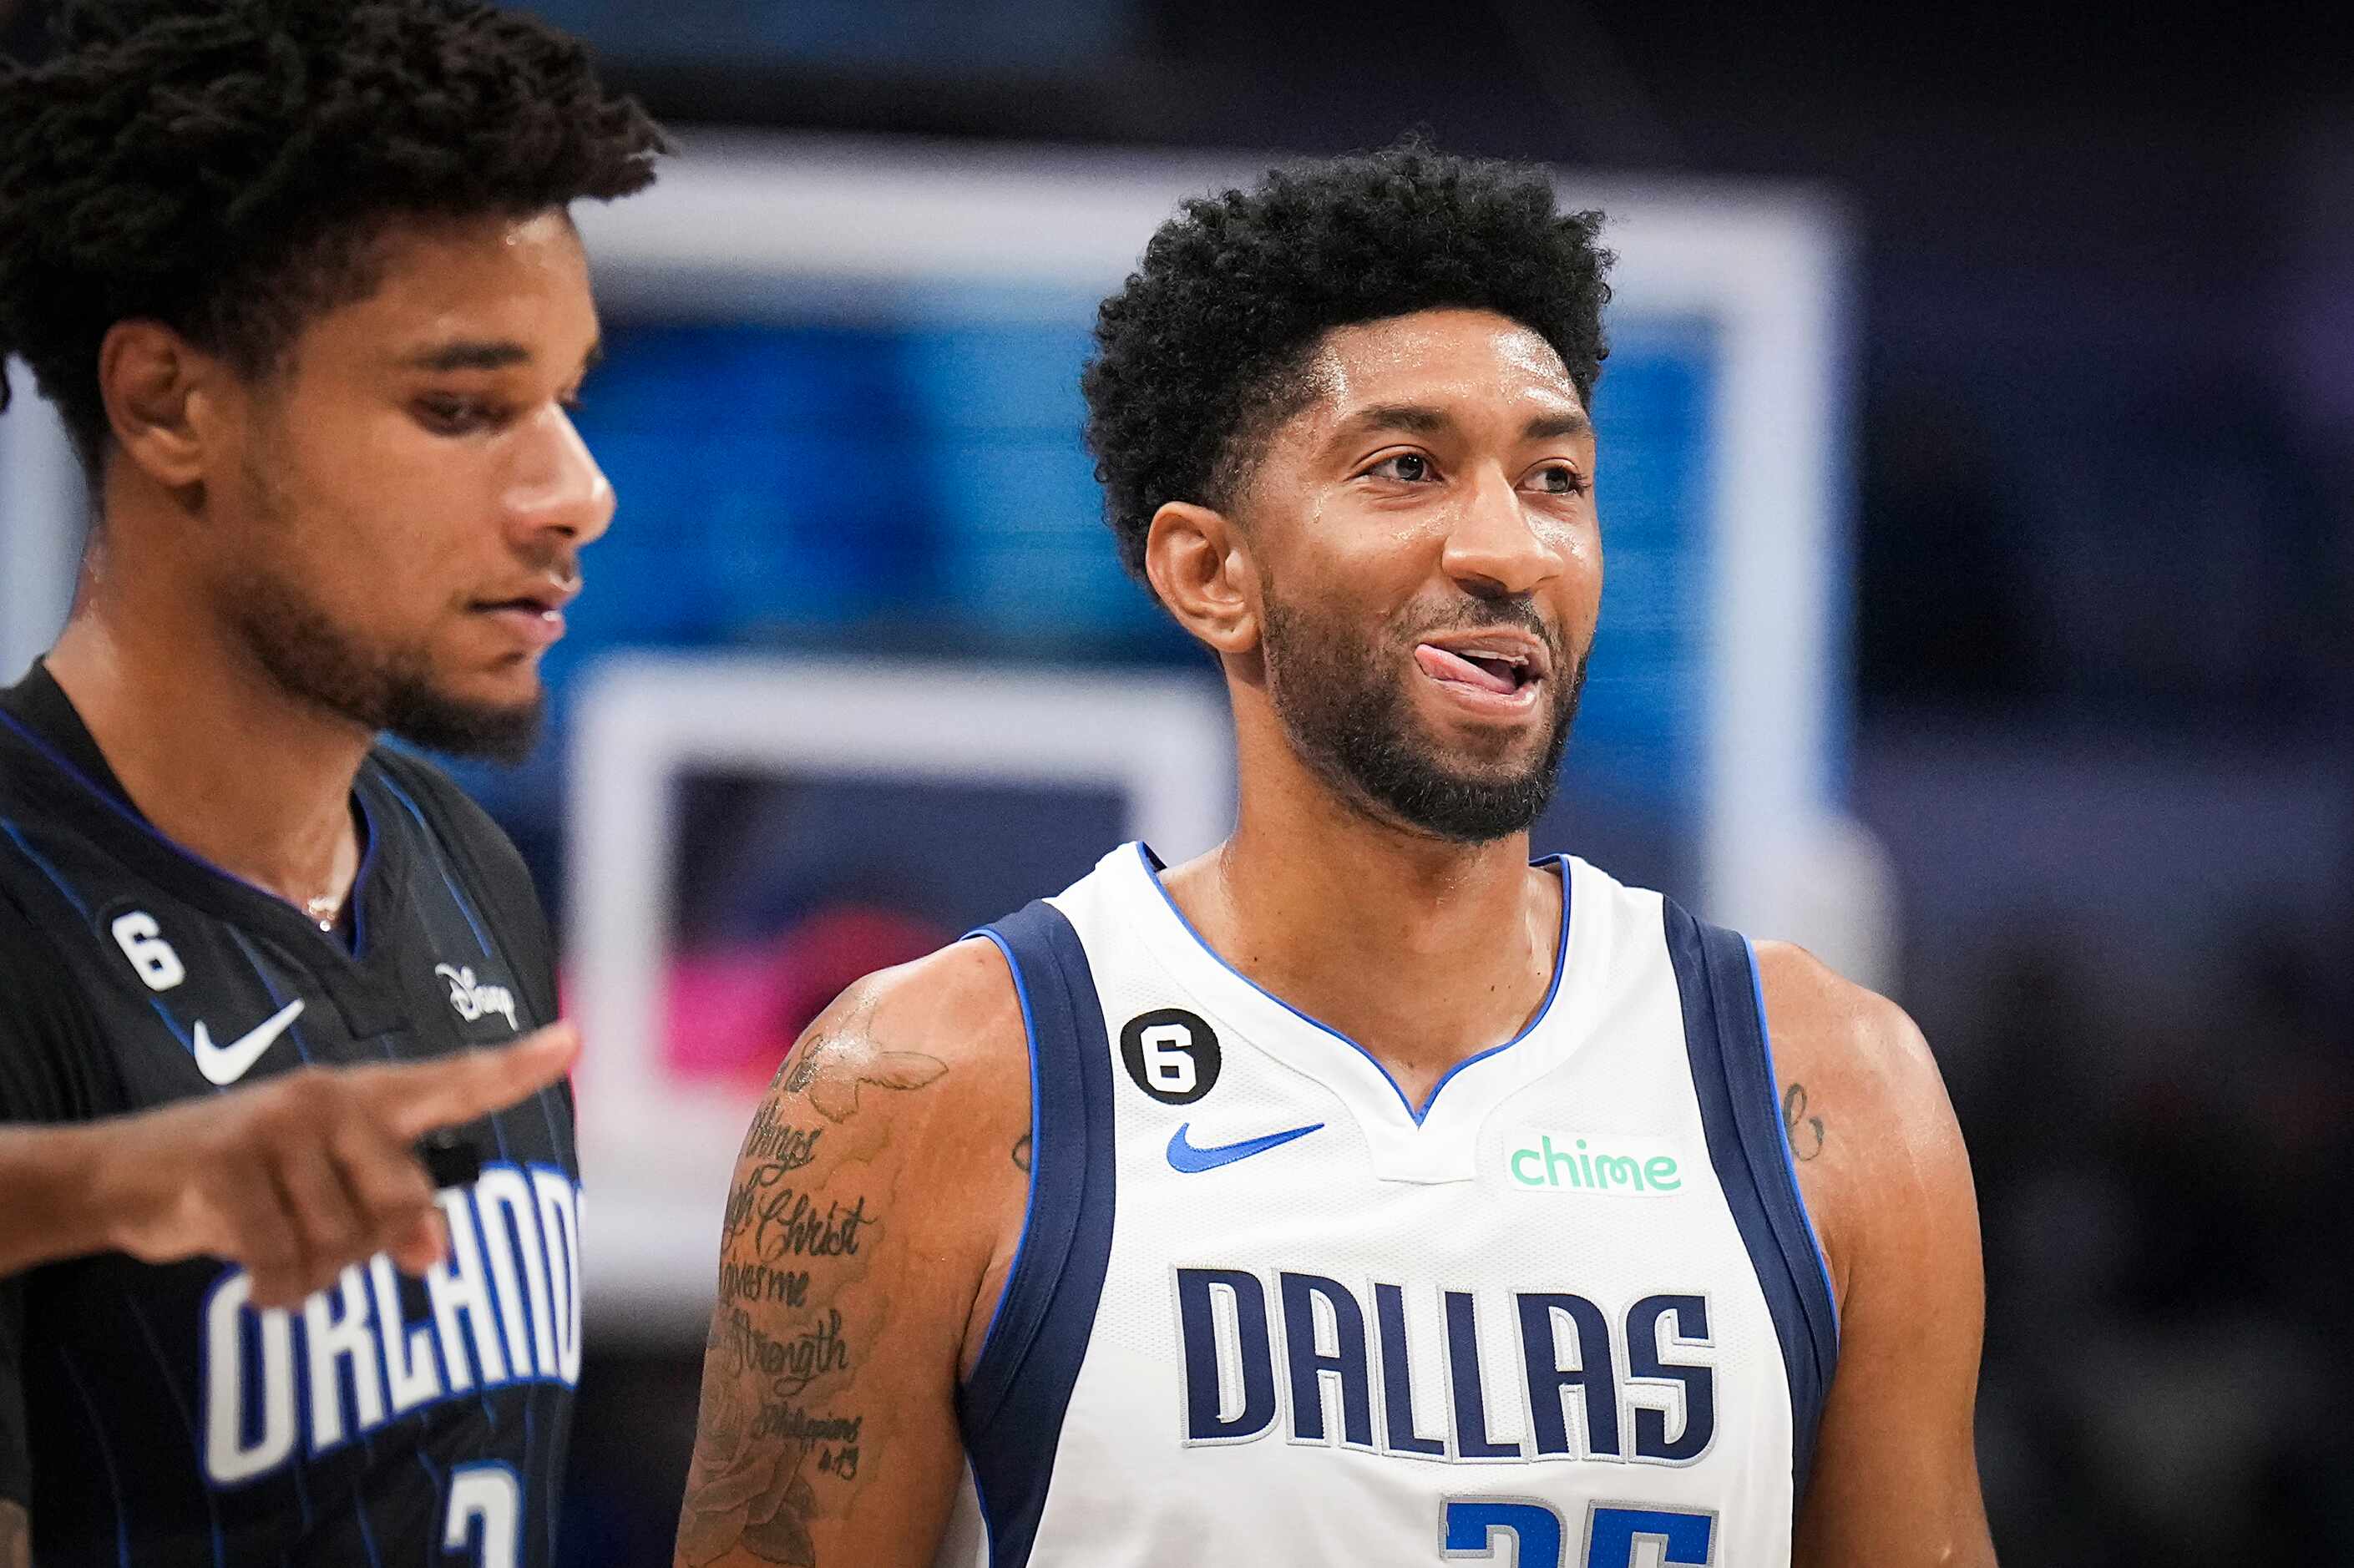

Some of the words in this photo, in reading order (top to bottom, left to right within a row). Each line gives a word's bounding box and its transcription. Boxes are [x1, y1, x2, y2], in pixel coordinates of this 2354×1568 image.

[112, 910, 186, 992] 6
[1139, 1024, 1197, 1094] 6
[1511, 1136, 1682, 1191] chime
[202, 1161, 584, 1485] ORLAND
[1170, 1262, 1719, 1468] DALLAS
